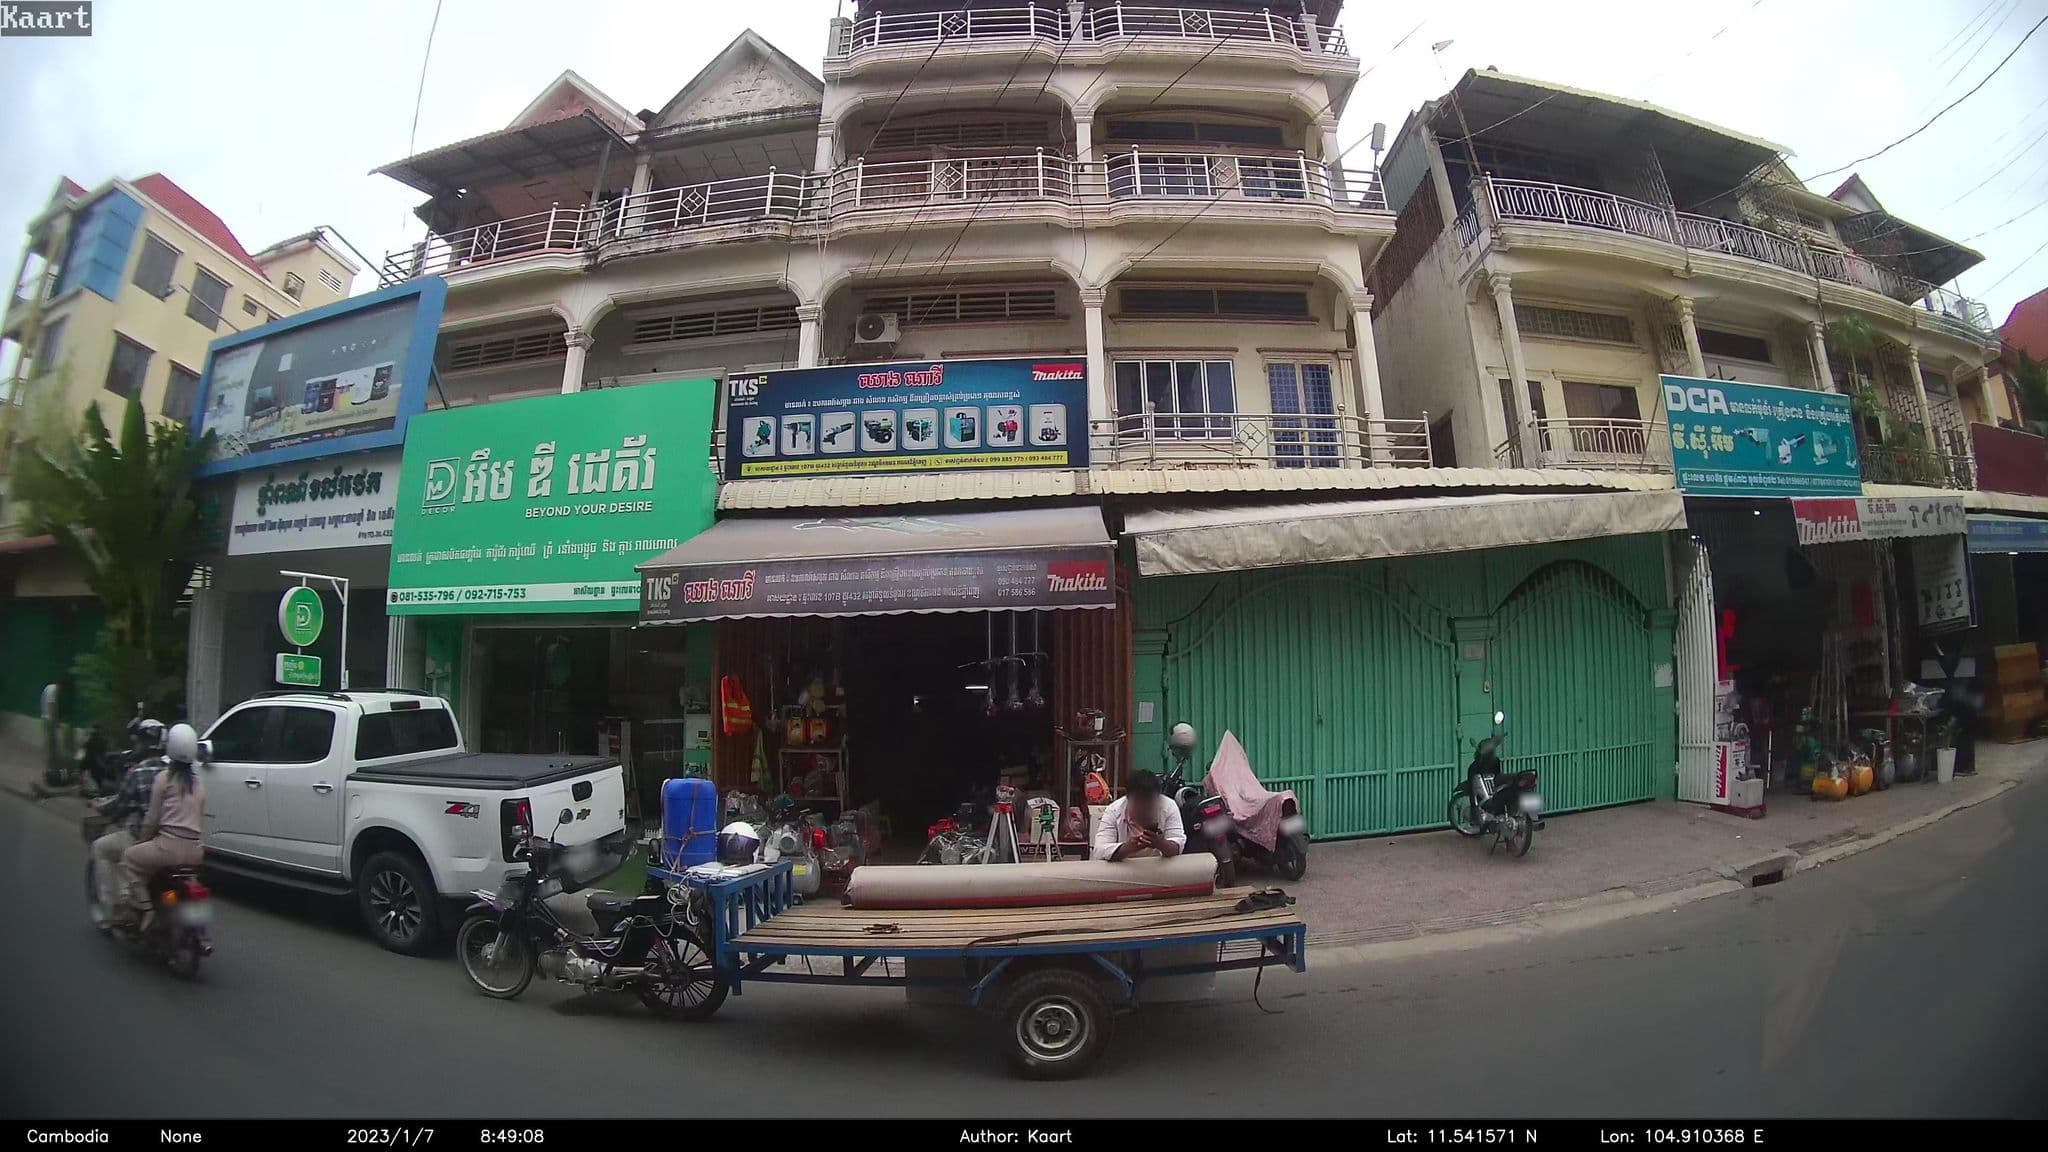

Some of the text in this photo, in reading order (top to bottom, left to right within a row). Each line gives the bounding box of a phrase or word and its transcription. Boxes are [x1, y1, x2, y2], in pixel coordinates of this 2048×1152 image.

[729, 378, 759, 397] TKS
[1664, 385, 1729, 414] DCA
[526, 501, 653, 518] BEYOND YOUR DESIRE
[400, 590, 454, 602] 081-535-796
[465, 588, 526, 600] 092-715-753
[646, 577, 671, 600] TKS
